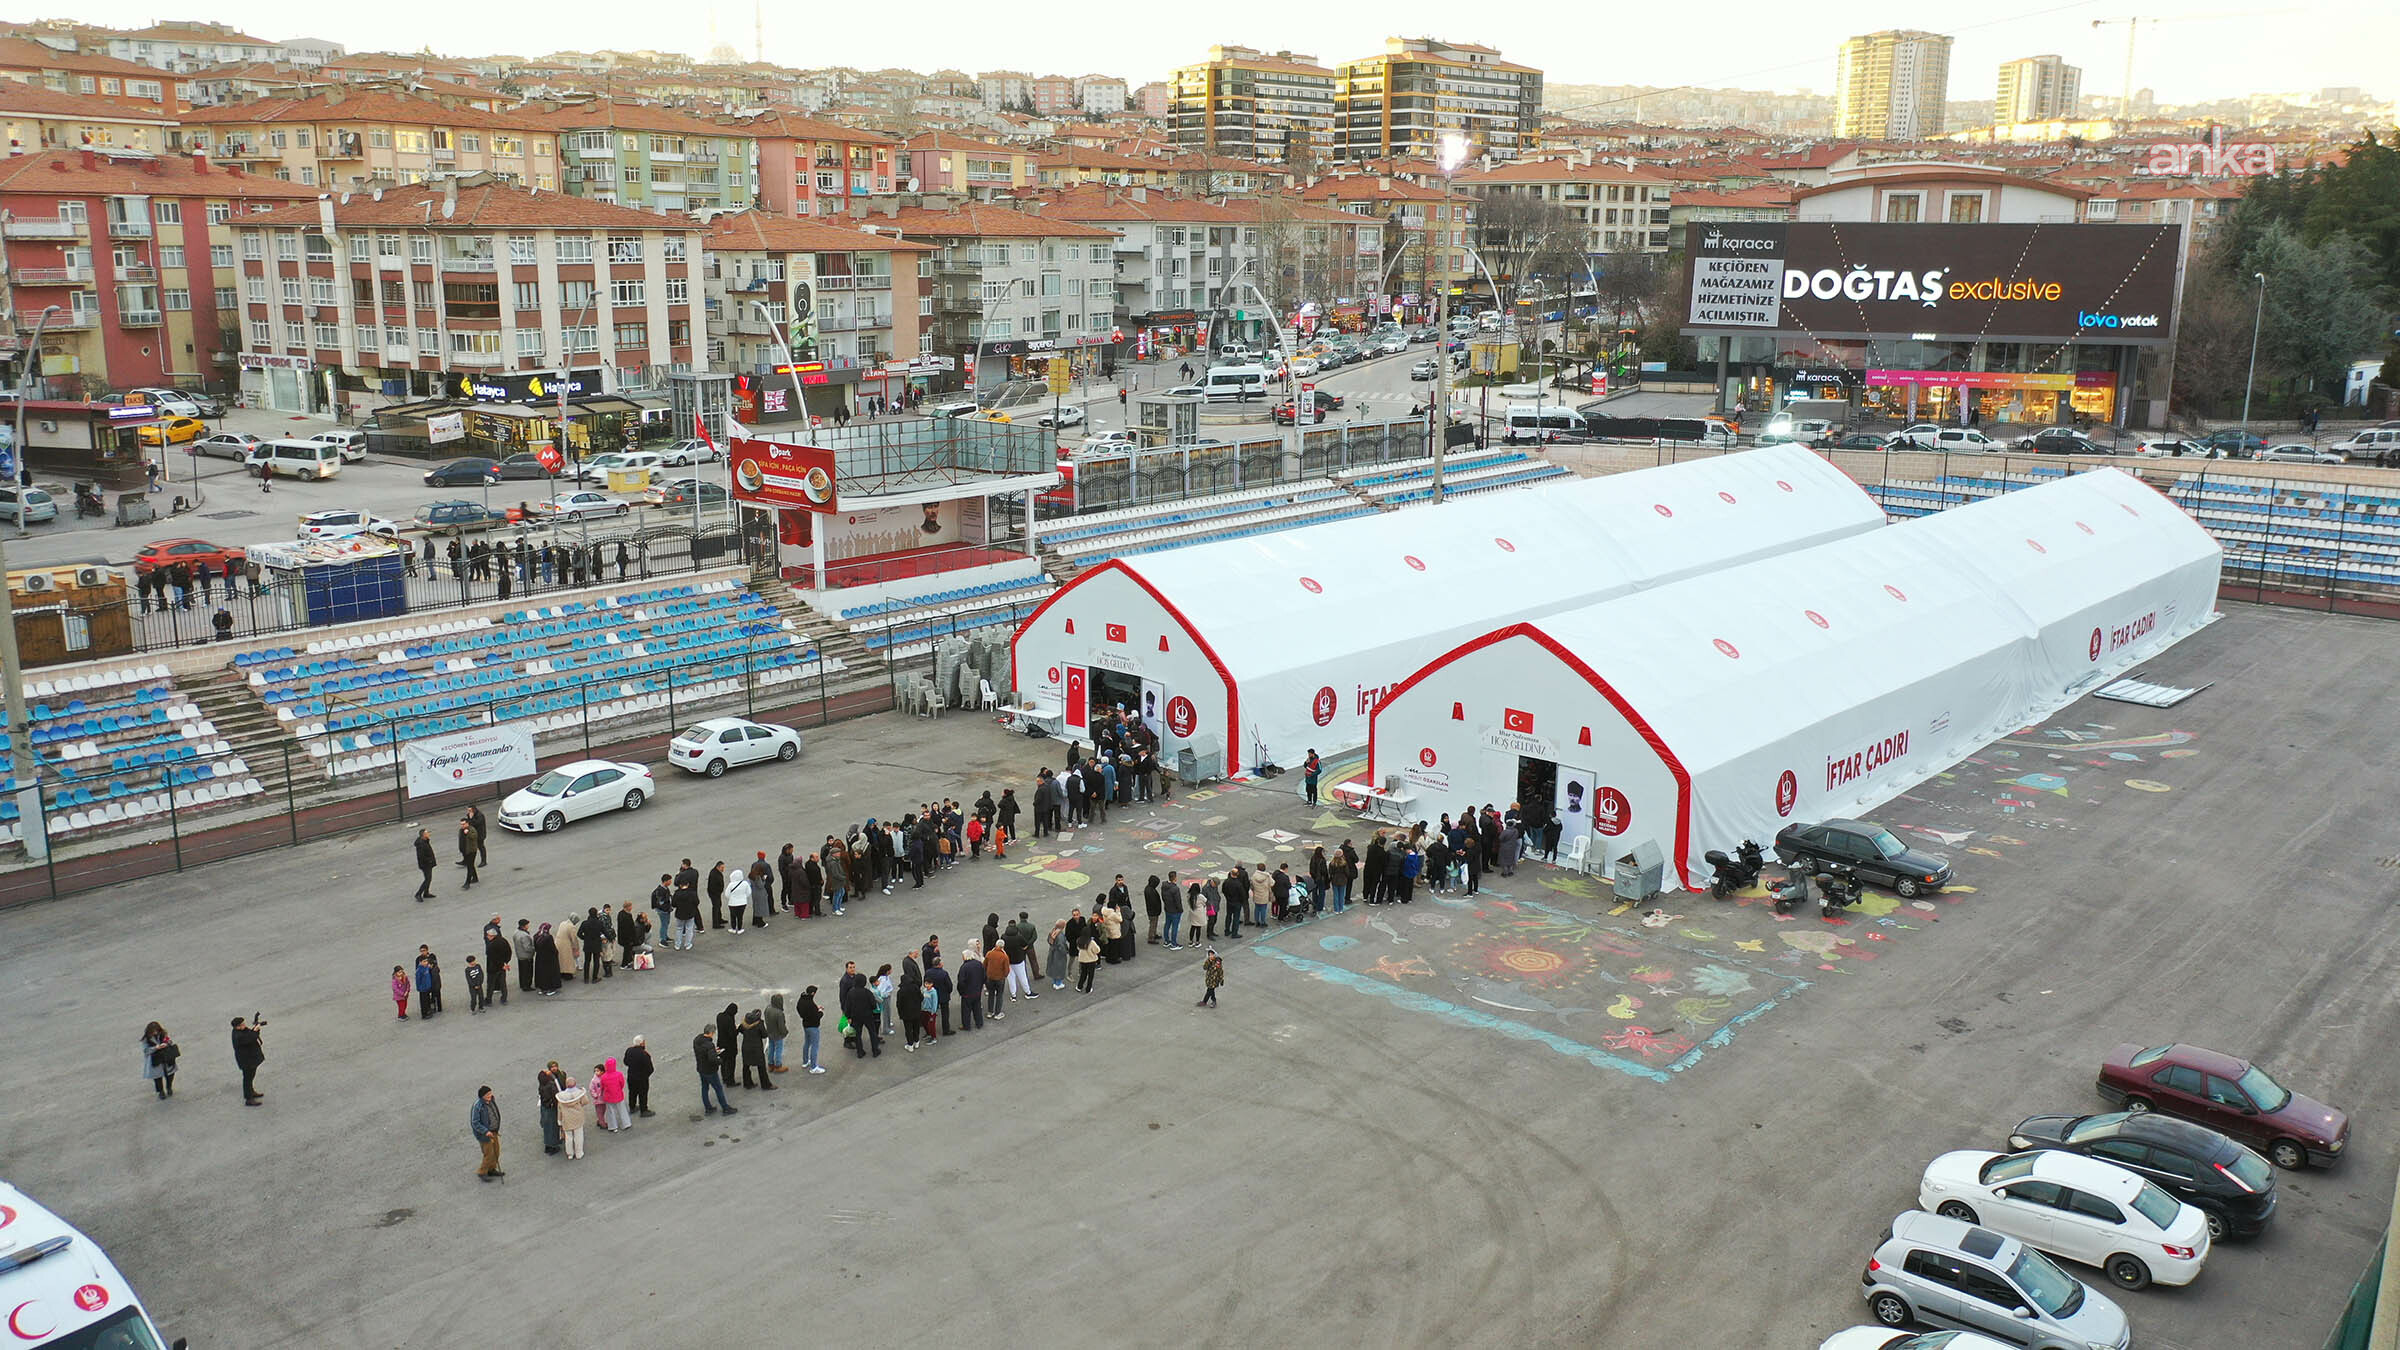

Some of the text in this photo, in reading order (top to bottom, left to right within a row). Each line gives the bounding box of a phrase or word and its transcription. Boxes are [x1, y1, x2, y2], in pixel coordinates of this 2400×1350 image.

[1722, 238, 1775, 250] karaca
[1709, 260, 1769, 274] KEÇİÖREN
[1700, 275, 1775, 290] MAĞAZAMIZ
[1783, 263, 2062, 308] DOĞTAŞ exclusive
[1698, 292, 1775, 306] HİZMETİNİZE
[1697, 309, 1769, 323] AÇILMIŞTIR.
[2078, 310, 2160, 329] lova yatak
[1807, 374, 1840, 382] karaca
[473, 384, 506, 397] Hatayca
[541, 451, 554, 460] M
[2110, 624, 2130, 652] İFTAR
[1491, 735, 1509, 750] HOŞ
[427, 752, 459, 770] Hayırlı
[461, 744, 514, 764] Ramazanlar
[1826, 729, 1909, 793] İFTAR ÇADIRI
